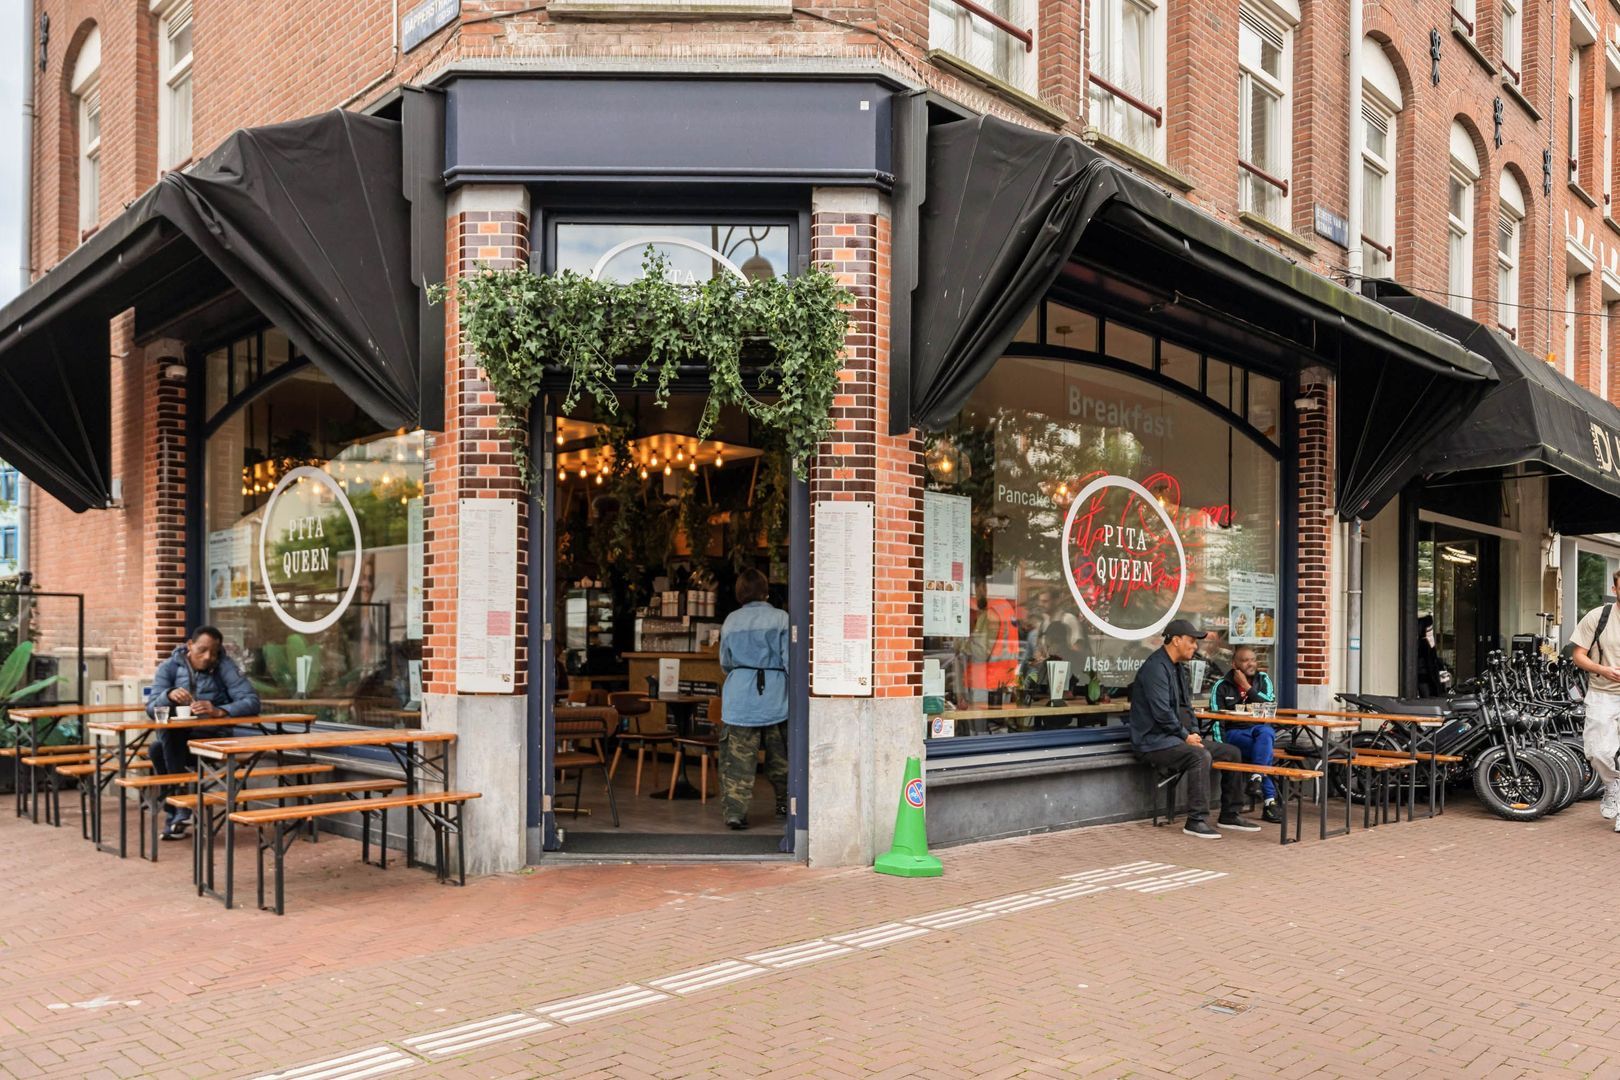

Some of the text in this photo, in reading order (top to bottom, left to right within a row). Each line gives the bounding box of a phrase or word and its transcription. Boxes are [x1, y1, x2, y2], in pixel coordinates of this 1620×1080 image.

[1068, 384, 1176, 440] Breakfast
[998, 484, 1058, 510] Pancakes
[289, 516, 325, 541] PITA
[1103, 524, 1147, 551] PITA
[283, 547, 330, 578] QUEEN
[1096, 555, 1153, 584] QUEEN
[1083, 655, 1110, 672] Also
